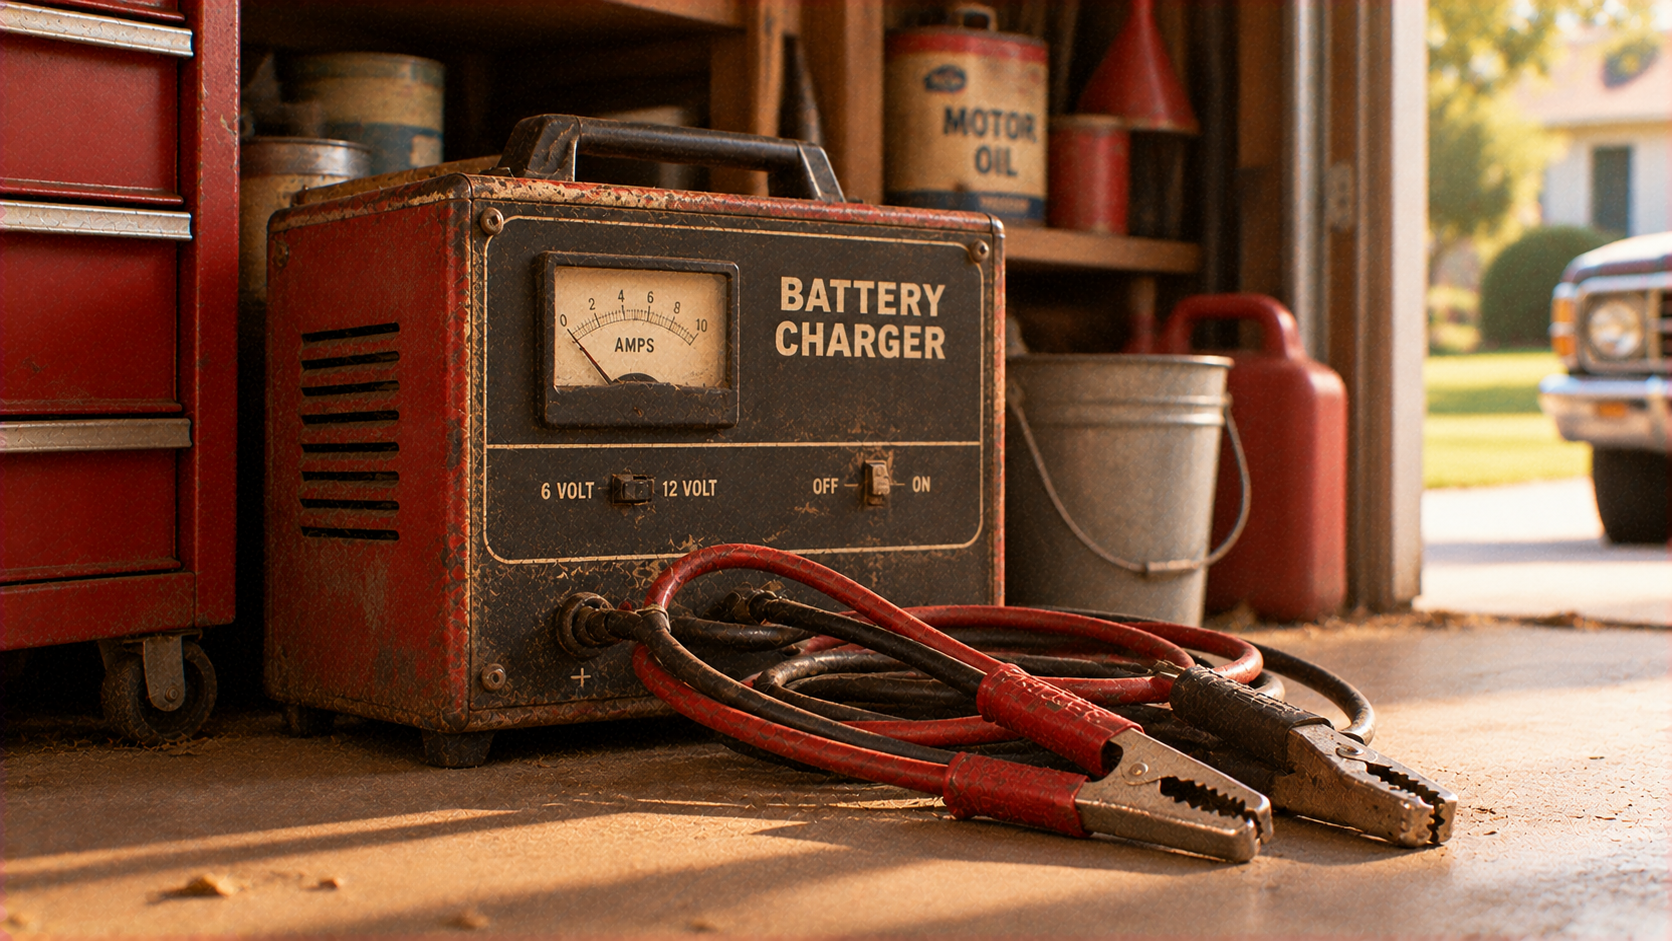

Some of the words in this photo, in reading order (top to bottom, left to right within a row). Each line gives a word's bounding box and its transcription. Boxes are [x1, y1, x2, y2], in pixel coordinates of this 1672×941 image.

[943, 106, 1037, 143] MOTOR
[975, 145, 1018, 177] OIL
[780, 276, 946, 317] BATTERY
[559, 313, 568, 327] 0
[588, 297, 596, 310] 2
[617, 289, 625, 303] 4
[646, 290, 654, 304] 6
[673, 301, 681, 314] 8
[695, 318, 708, 332] 10
[614, 336, 655, 353] AMPS
[775, 320, 946, 360] CHARGER
[540, 482, 551, 500] 6
[556, 481, 595, 500] VOLT
[662, 480, 678, 497] 12
[682, 479, 718, 497] VOLT
[812, 477, 839, 495] OFF
[912, 475, 931, 493] ON
